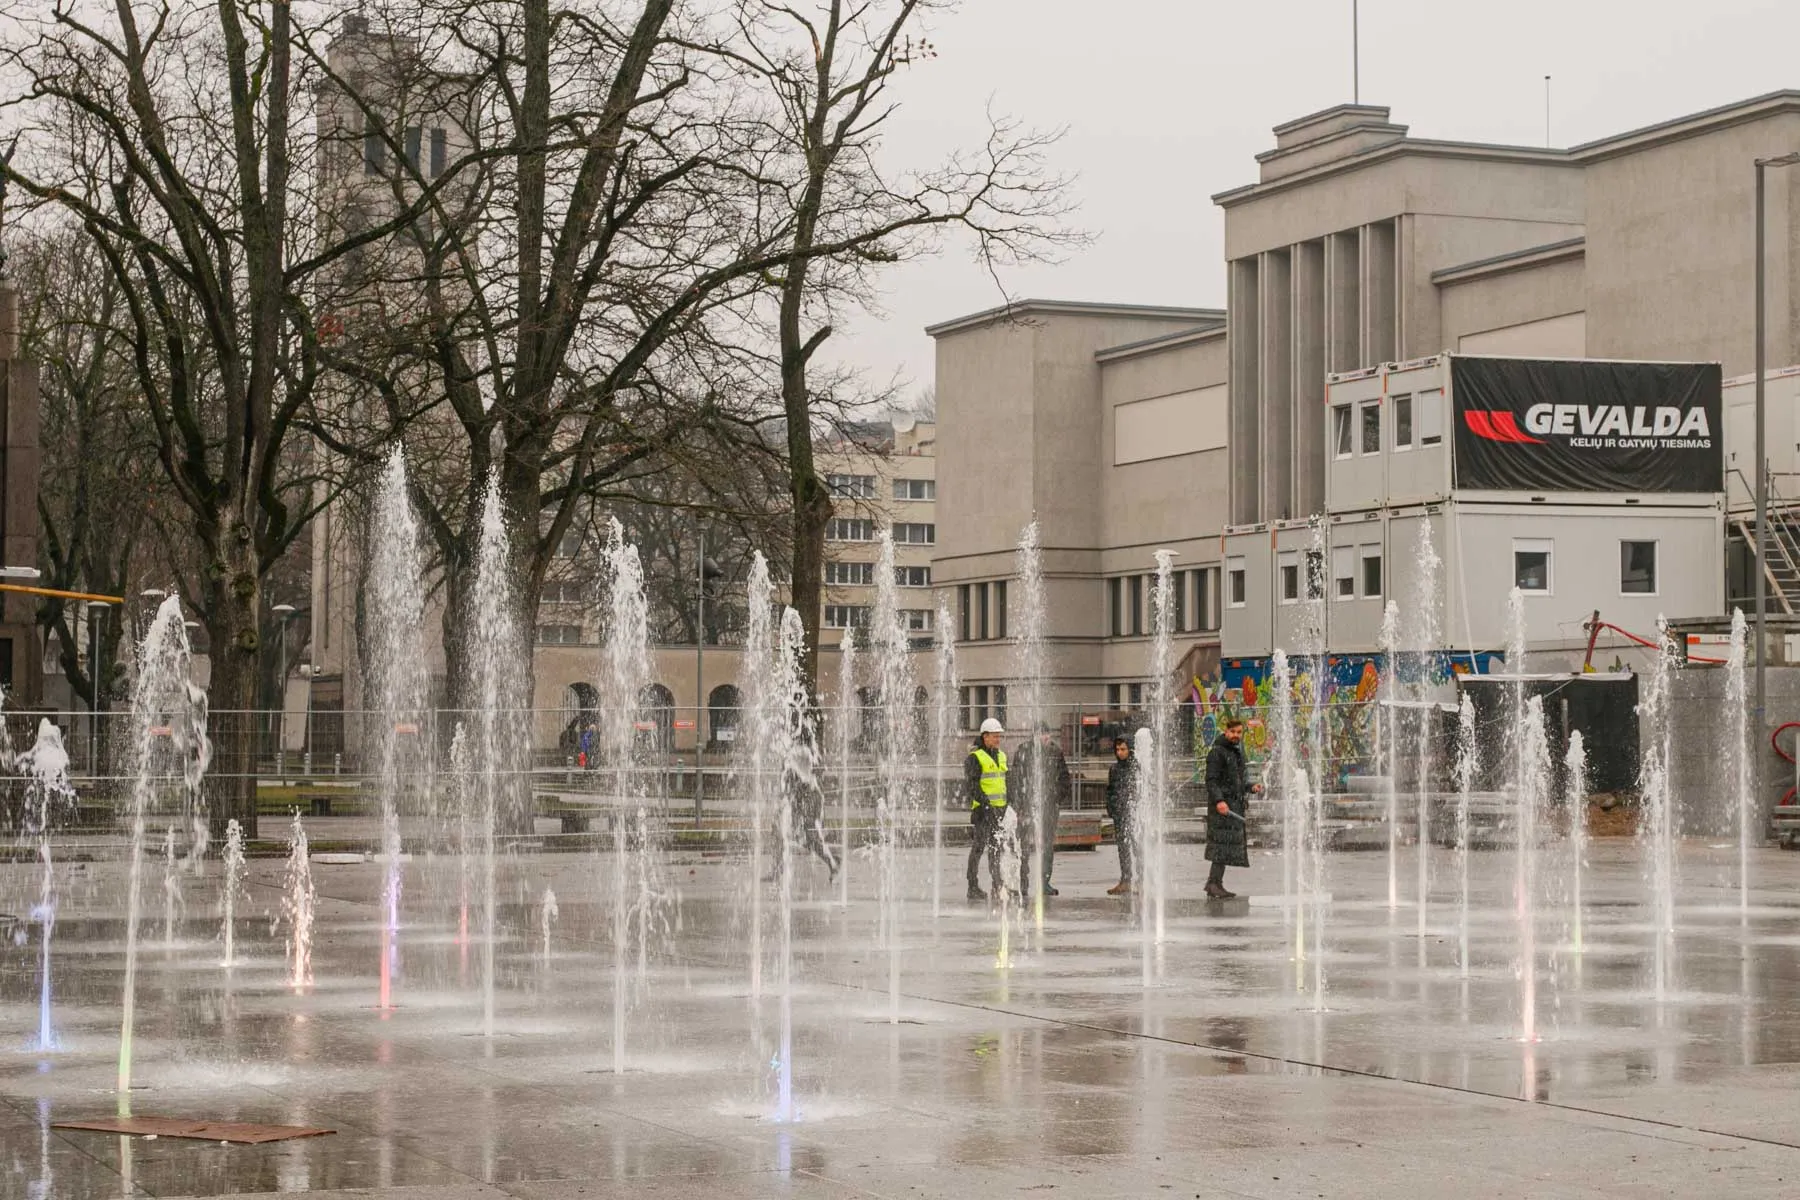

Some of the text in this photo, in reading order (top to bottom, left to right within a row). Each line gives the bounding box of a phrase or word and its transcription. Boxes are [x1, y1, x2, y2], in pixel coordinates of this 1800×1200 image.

[1525, 403, 1711, 437] GEVALDA
[1570, 437, 1712, 450] KELIŲ IR GATVIŲ TIESIMAS
